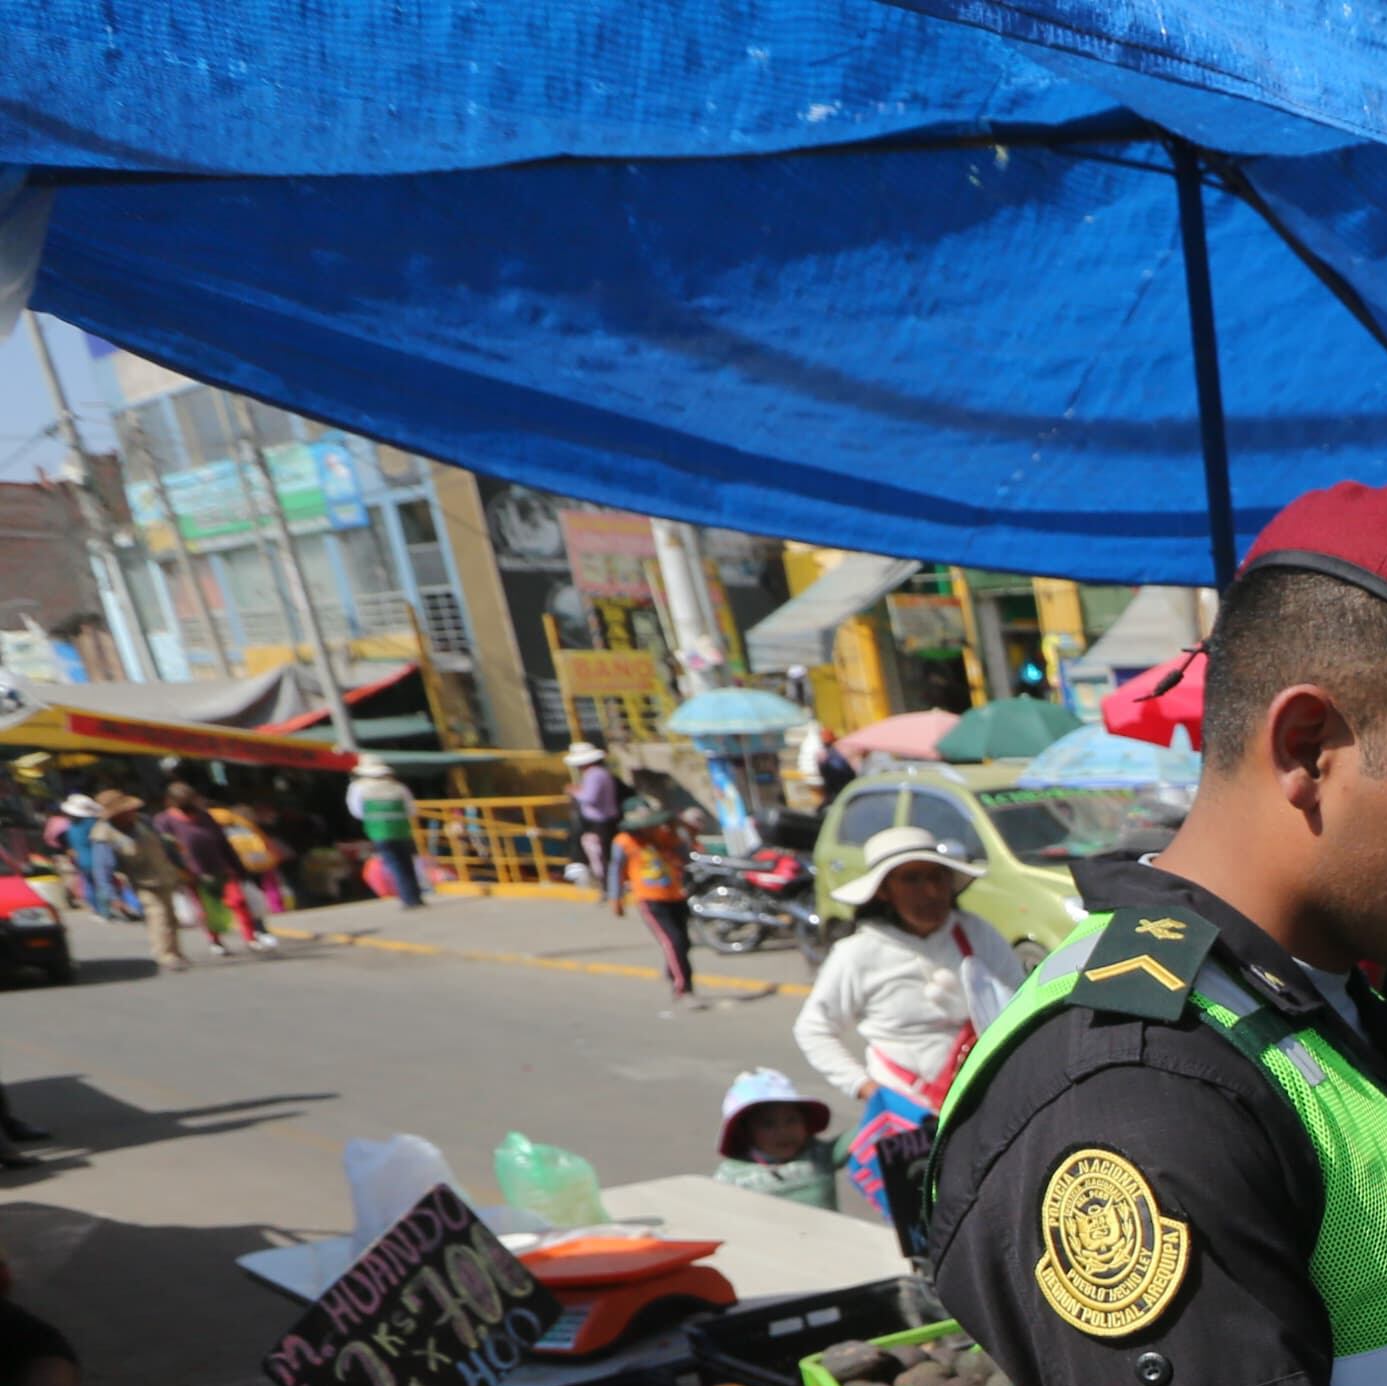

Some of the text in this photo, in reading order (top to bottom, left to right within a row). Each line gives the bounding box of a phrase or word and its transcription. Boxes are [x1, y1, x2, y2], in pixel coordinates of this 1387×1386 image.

[1049, 1157, 1142, 1228] POLICIA NACIONAL
[318, 1187, 471, 1336] HUANDO
[1042, 1230, 1180, 1329] REGION POLICIAL AREQUIPA
[1066, 1267, 1107, 1301] PUEBLO
[1139, 1248, 1153, 1275] LEY
